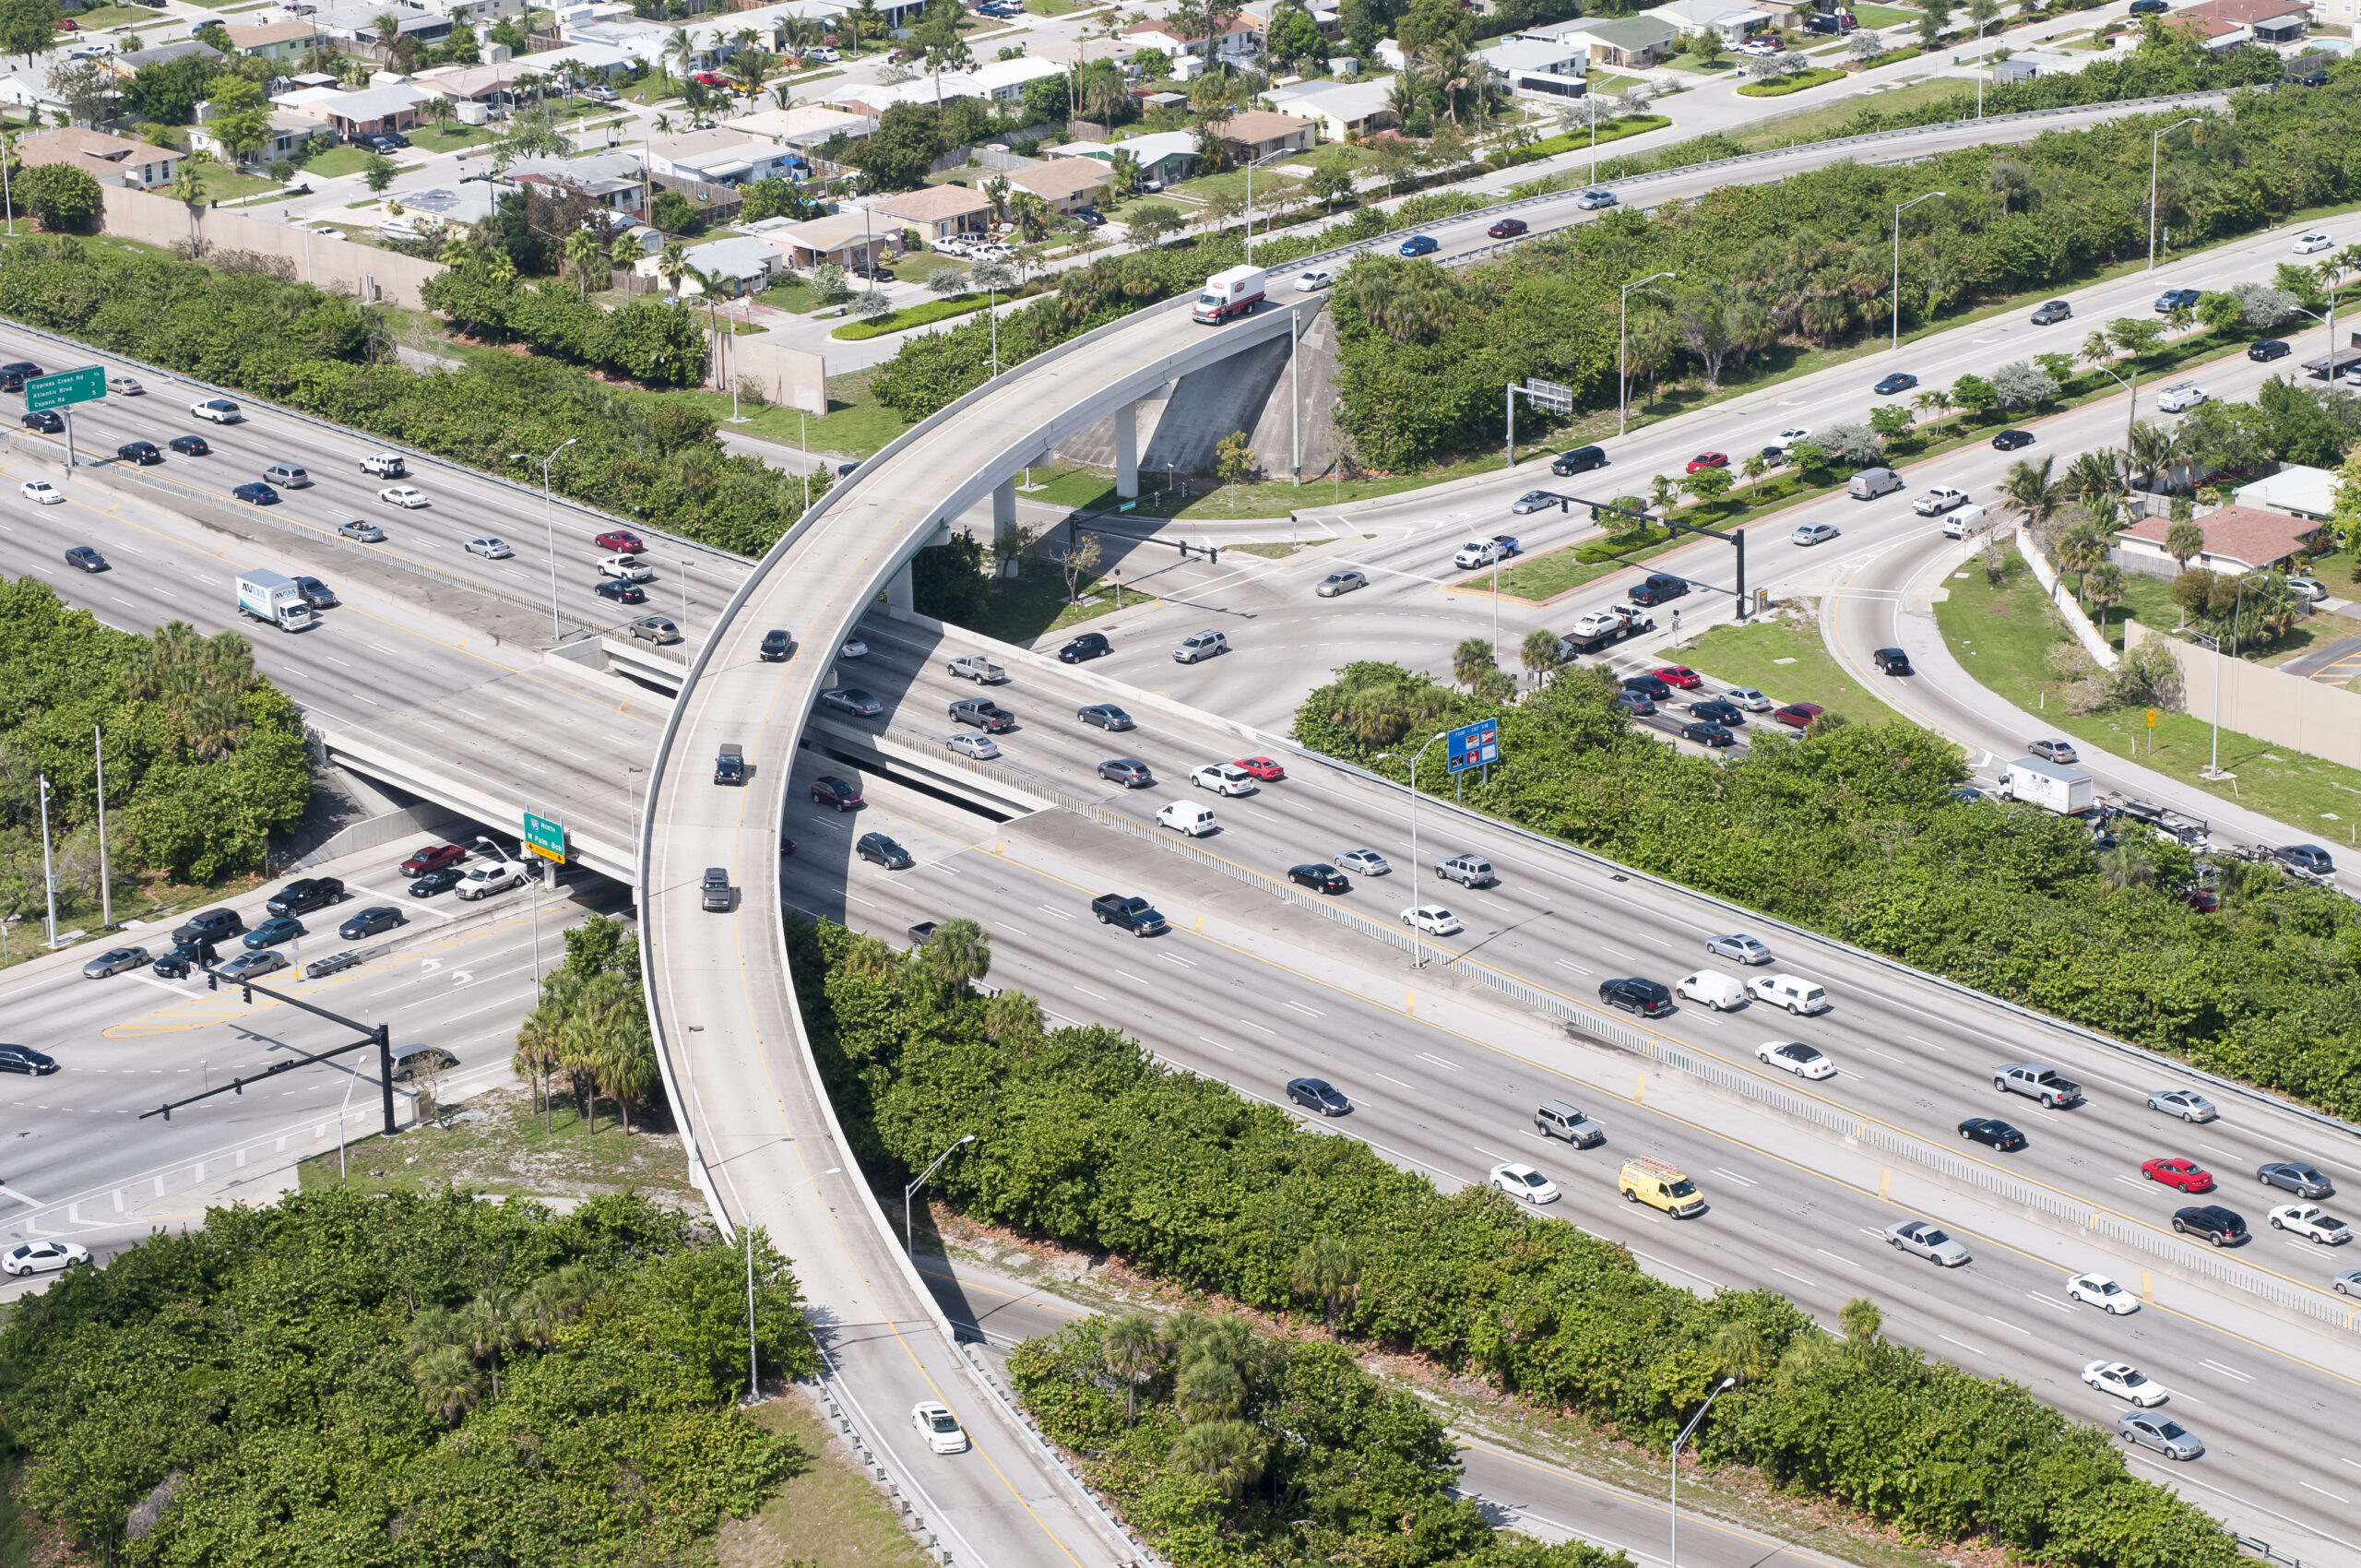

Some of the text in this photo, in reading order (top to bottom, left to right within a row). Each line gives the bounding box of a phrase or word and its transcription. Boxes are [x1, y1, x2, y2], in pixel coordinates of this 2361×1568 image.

[31, 382, 55, 390] Cypress
[33, 390, 57, 398] Atlantic
[242, 582, 266, 599] AVDA
[274, 588, 296, 599] AVDA
[540, 822, 555, 832] NORTH
[534, 835, 548, 846] Palm
[551, 842, 562, 851] Bch
